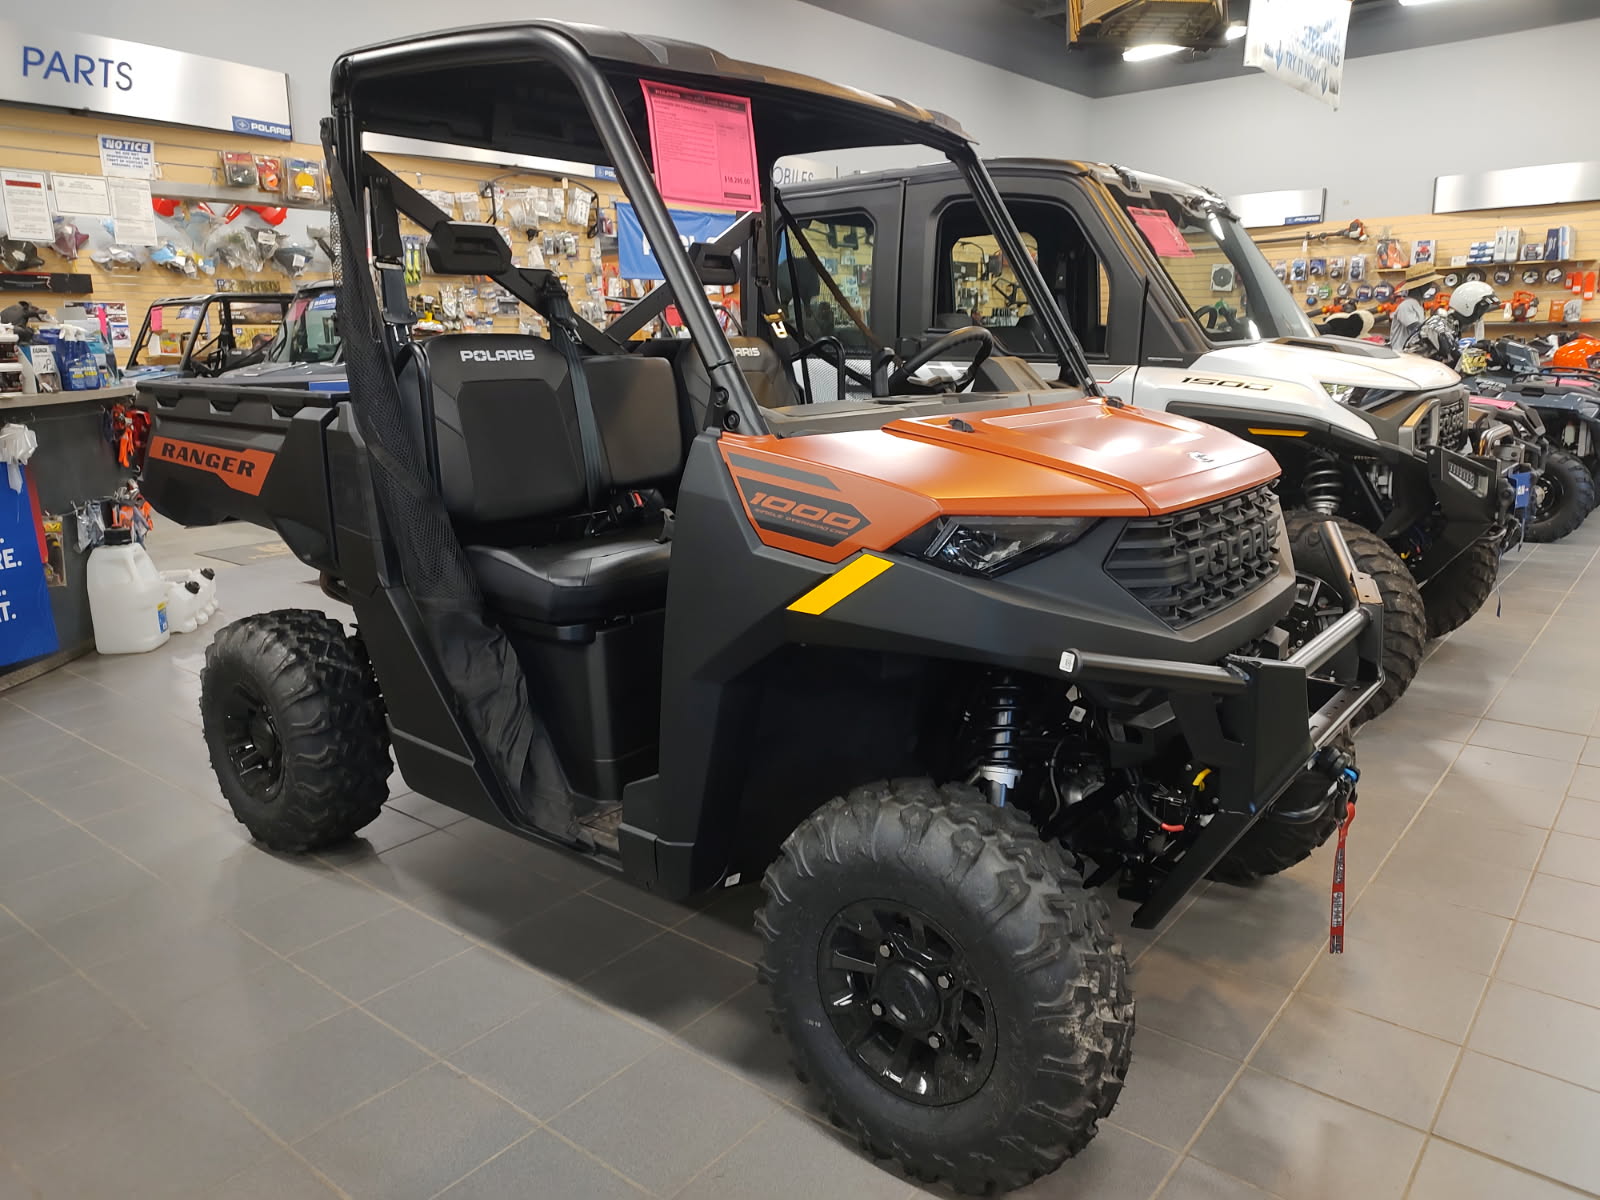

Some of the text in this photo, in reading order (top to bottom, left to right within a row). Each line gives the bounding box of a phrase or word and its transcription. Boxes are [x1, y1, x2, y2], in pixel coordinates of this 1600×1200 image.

[22, 45, 133, 91] PARTS
[251, 122, 291, 136] POLARIS
[105, 139, 149, 152] NOTICE
[460, 349, 536, 362] POLARIS
[161, 442, 256, 478] RANGER
[750, 492, 861, 530] 1000
